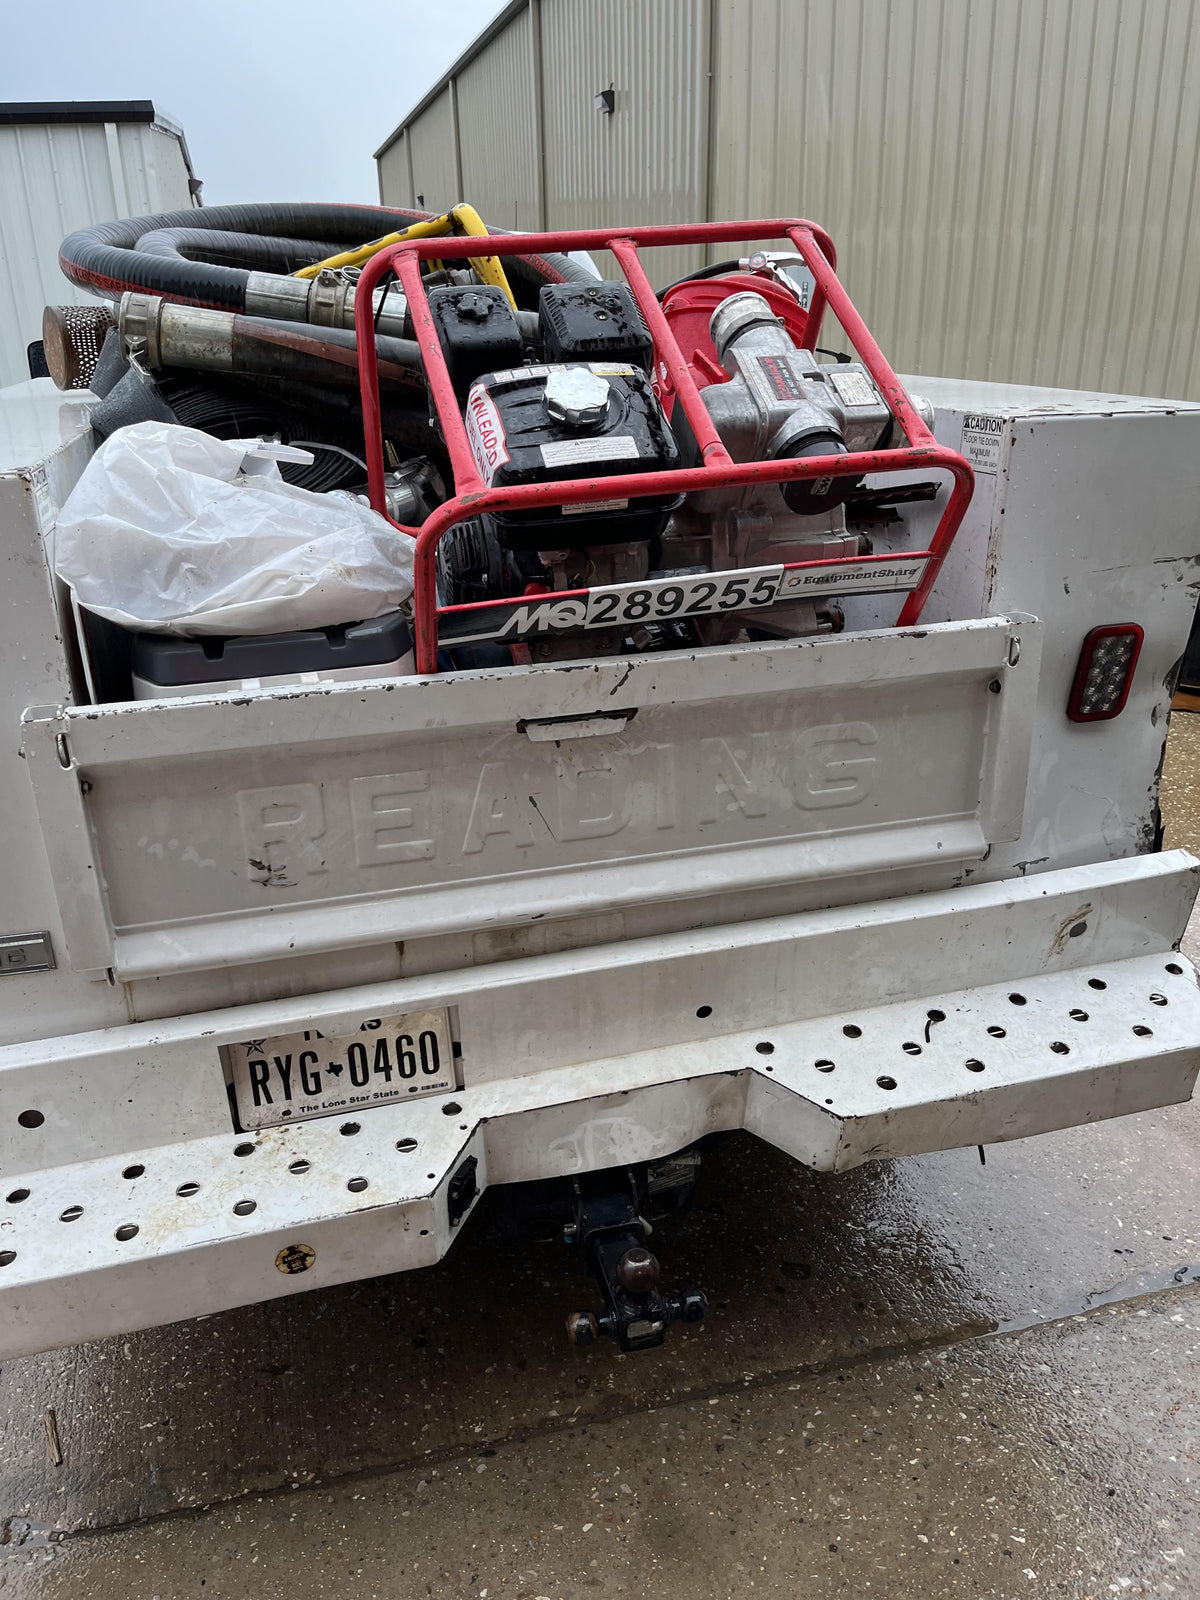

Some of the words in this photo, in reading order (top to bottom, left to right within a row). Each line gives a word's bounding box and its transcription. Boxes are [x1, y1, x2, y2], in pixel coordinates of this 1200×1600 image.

[970, 417, 1001, 432] CAUTION
[803, 567, 917, 585] EquipmentShare
[500, 599, 588, 636] MQ
[589, 574, 780, 624] 289255
[237, 721, 878, 883] READING
[248, 1051, 323, 1107] RYG
[347, 1030, 441, 1087] 0460
[299, 1104, 319, 1113] The
[322, 1098, 347, 1110] Lone
[349, 1093, 370, 1105] Star
[373, 1089, 400, 1100] State
